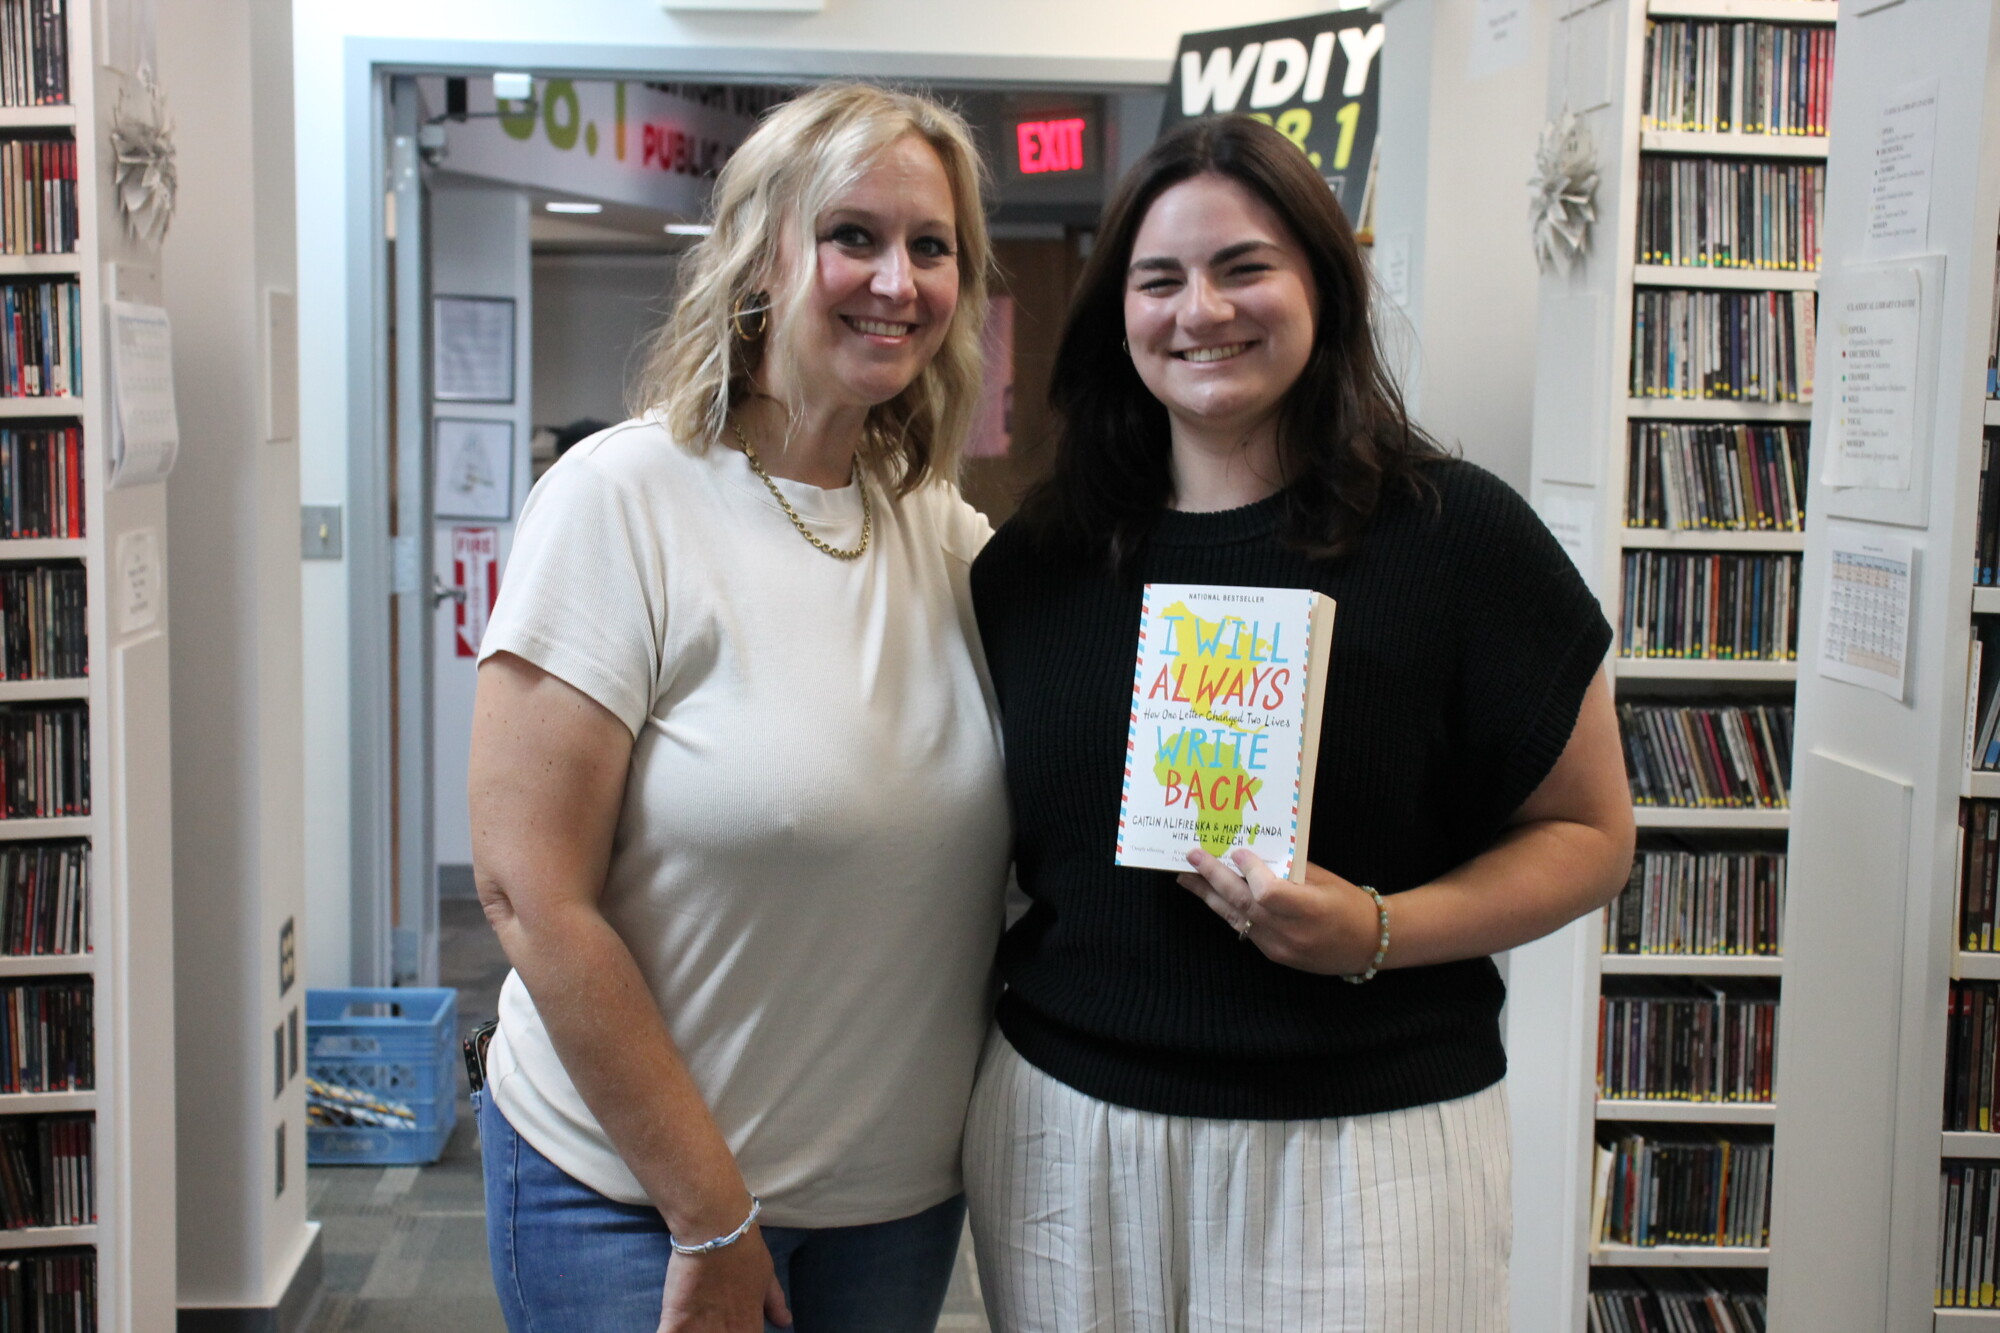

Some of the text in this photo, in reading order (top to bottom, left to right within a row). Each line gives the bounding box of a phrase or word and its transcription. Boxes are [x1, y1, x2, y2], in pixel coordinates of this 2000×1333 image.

[1181, 23, 1386, 116] WDIY
[1016, 118, 1086, 174] EXIT
[1249, 102, 1360, 170] 8.1
[1848, 325, 1867, 335] OPERA
[457, 537, 491, 555] FIRE
[1189, 593, 1265, 603] NATIONAL BESTSELLER
[1159, 615, 1289, 664] I WILL
[1148, 663, 1291, 711] ALWAYS
[1144, 708, 1291, 728] How One Letter Changed Two Lives
[1157, 726, 1269, 770] WRITE
[1165, 769, 1258, 812] BACK
[1132, 815, 1282, 837] CAITLIN ALIFIRENKA & MARTIN GANDA
[1172, 832, 1243, 846] WITH LIZ WELCH
